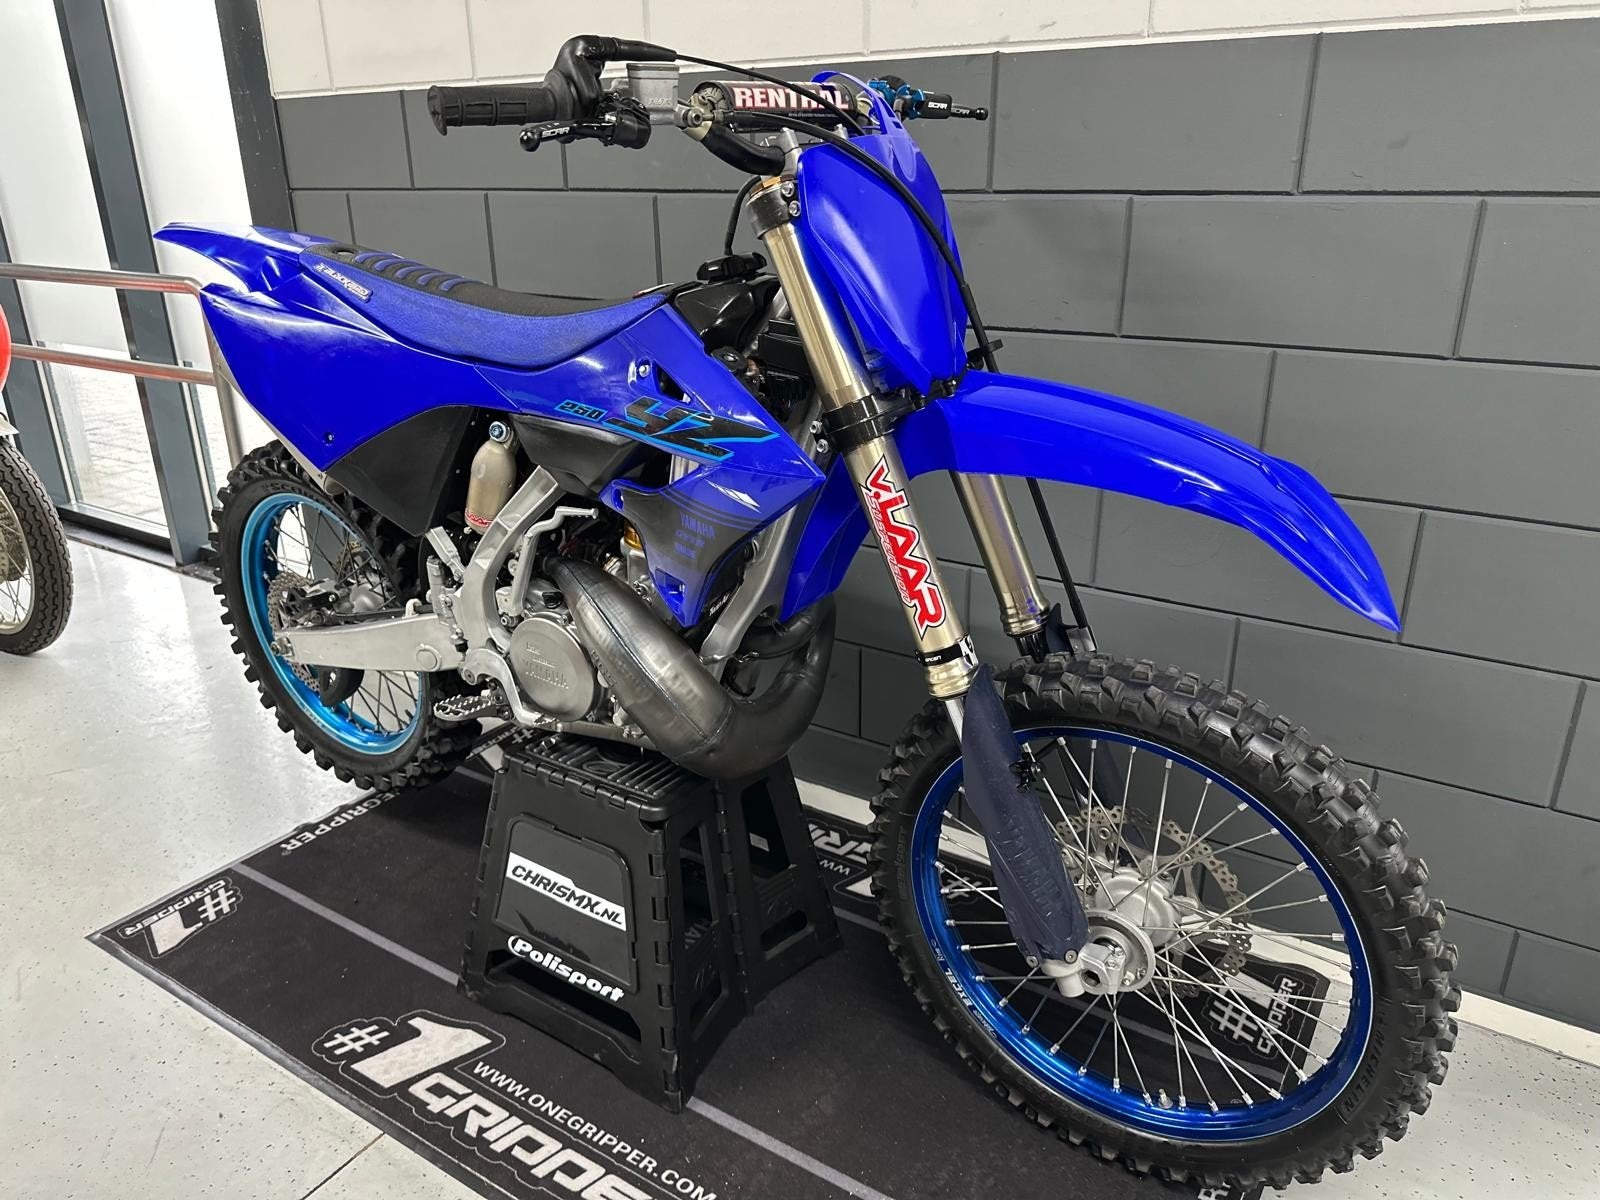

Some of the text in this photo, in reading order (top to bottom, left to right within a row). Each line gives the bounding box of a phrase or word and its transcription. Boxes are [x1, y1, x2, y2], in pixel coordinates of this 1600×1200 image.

[732, 87, 850, 109] RENTHAL
[556, 400, 608, 421] 250
[124, 880, 226, 935] GRIPPER
[148, 887, 237, 954] #1
[511, 865, 623, 925] CHRISMX.NL
[507, 935, 625, 1002] Polisport
[323, 1016, 492, 1088] #1
[408, 1072, 656, 1200] GRIPPE
[473, 1061, 718, 1200] WWW.ONEGRIPPER.COM
